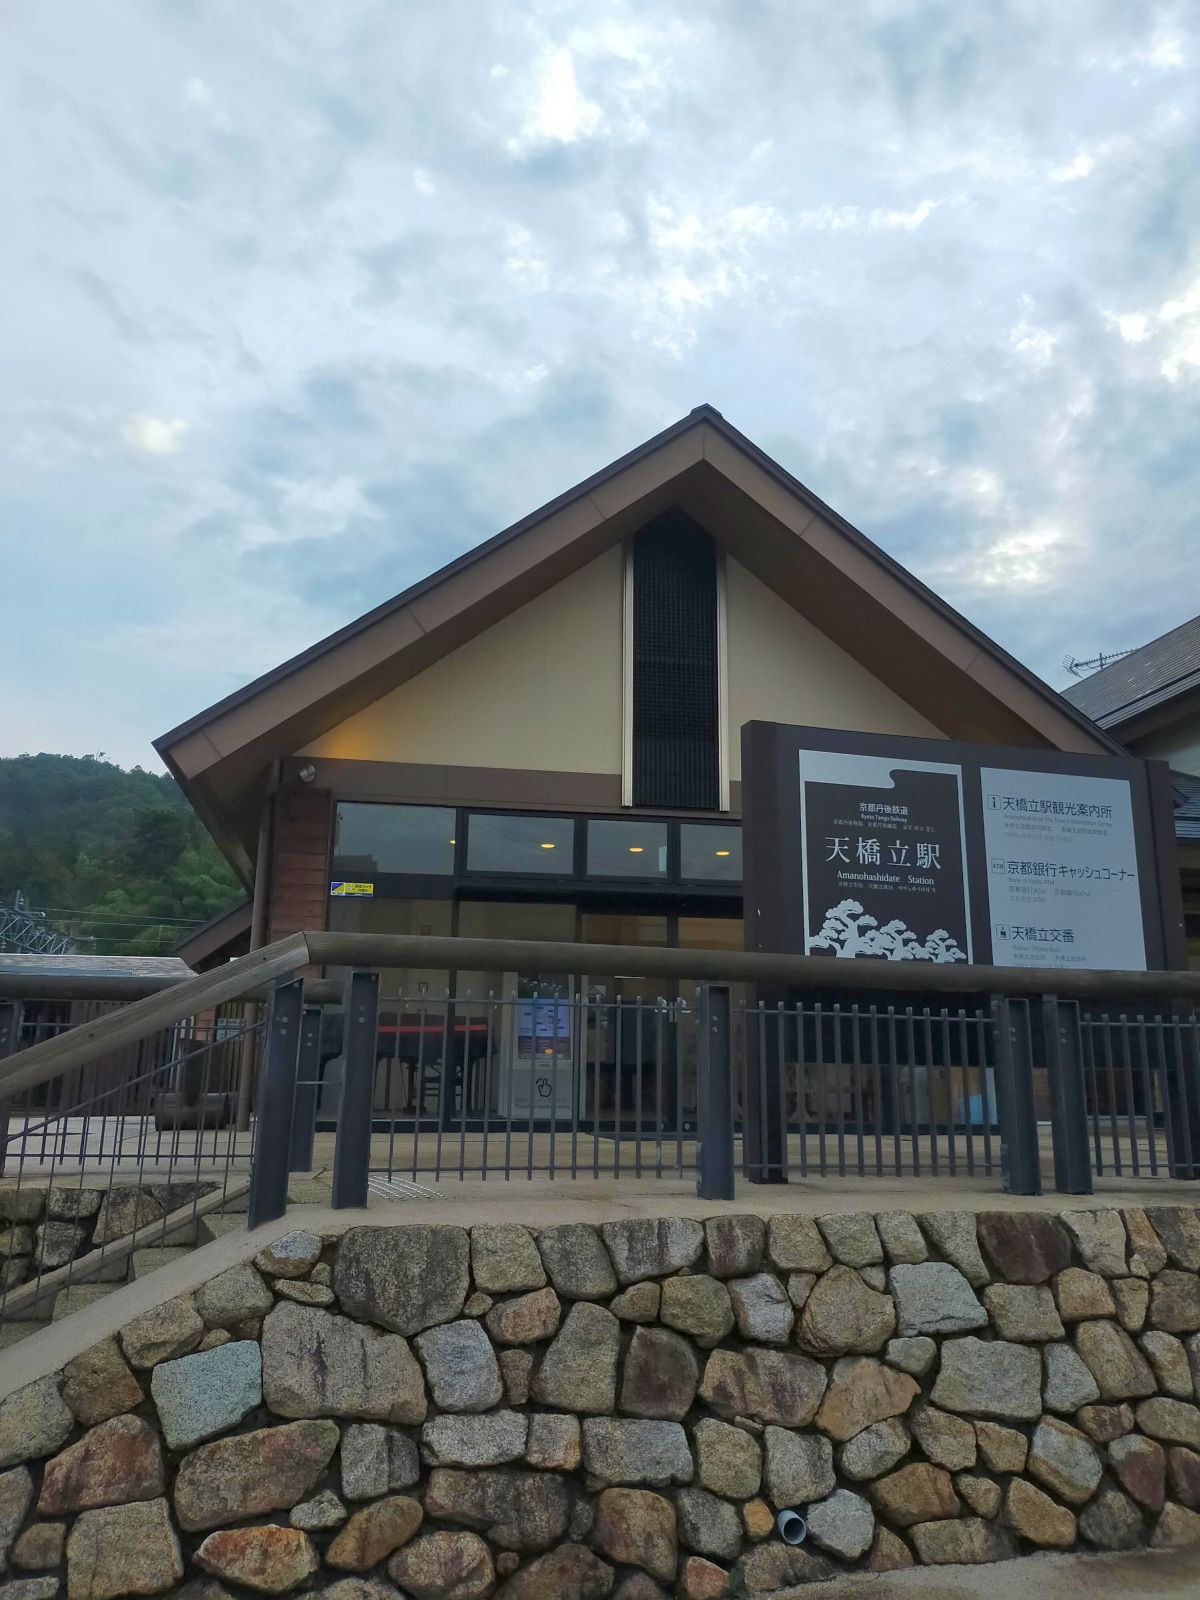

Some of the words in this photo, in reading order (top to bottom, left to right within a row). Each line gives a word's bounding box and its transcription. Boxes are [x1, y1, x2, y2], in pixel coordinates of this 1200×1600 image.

[859, 802, 908, 815] 京都丹後鉄道
[1002, 796, 1112, 819] 天橋立駅観光案内所
[825, 836, 941, 870] 天橋立駅
[837, 870, 900, 883] Amanohashidate
[907, 875, 935, 885] Station
[1007, 860, 1136, 881] 京都銀行キャッシュコーナー
[1011, 926, 1074, 943] 天橋立交番
